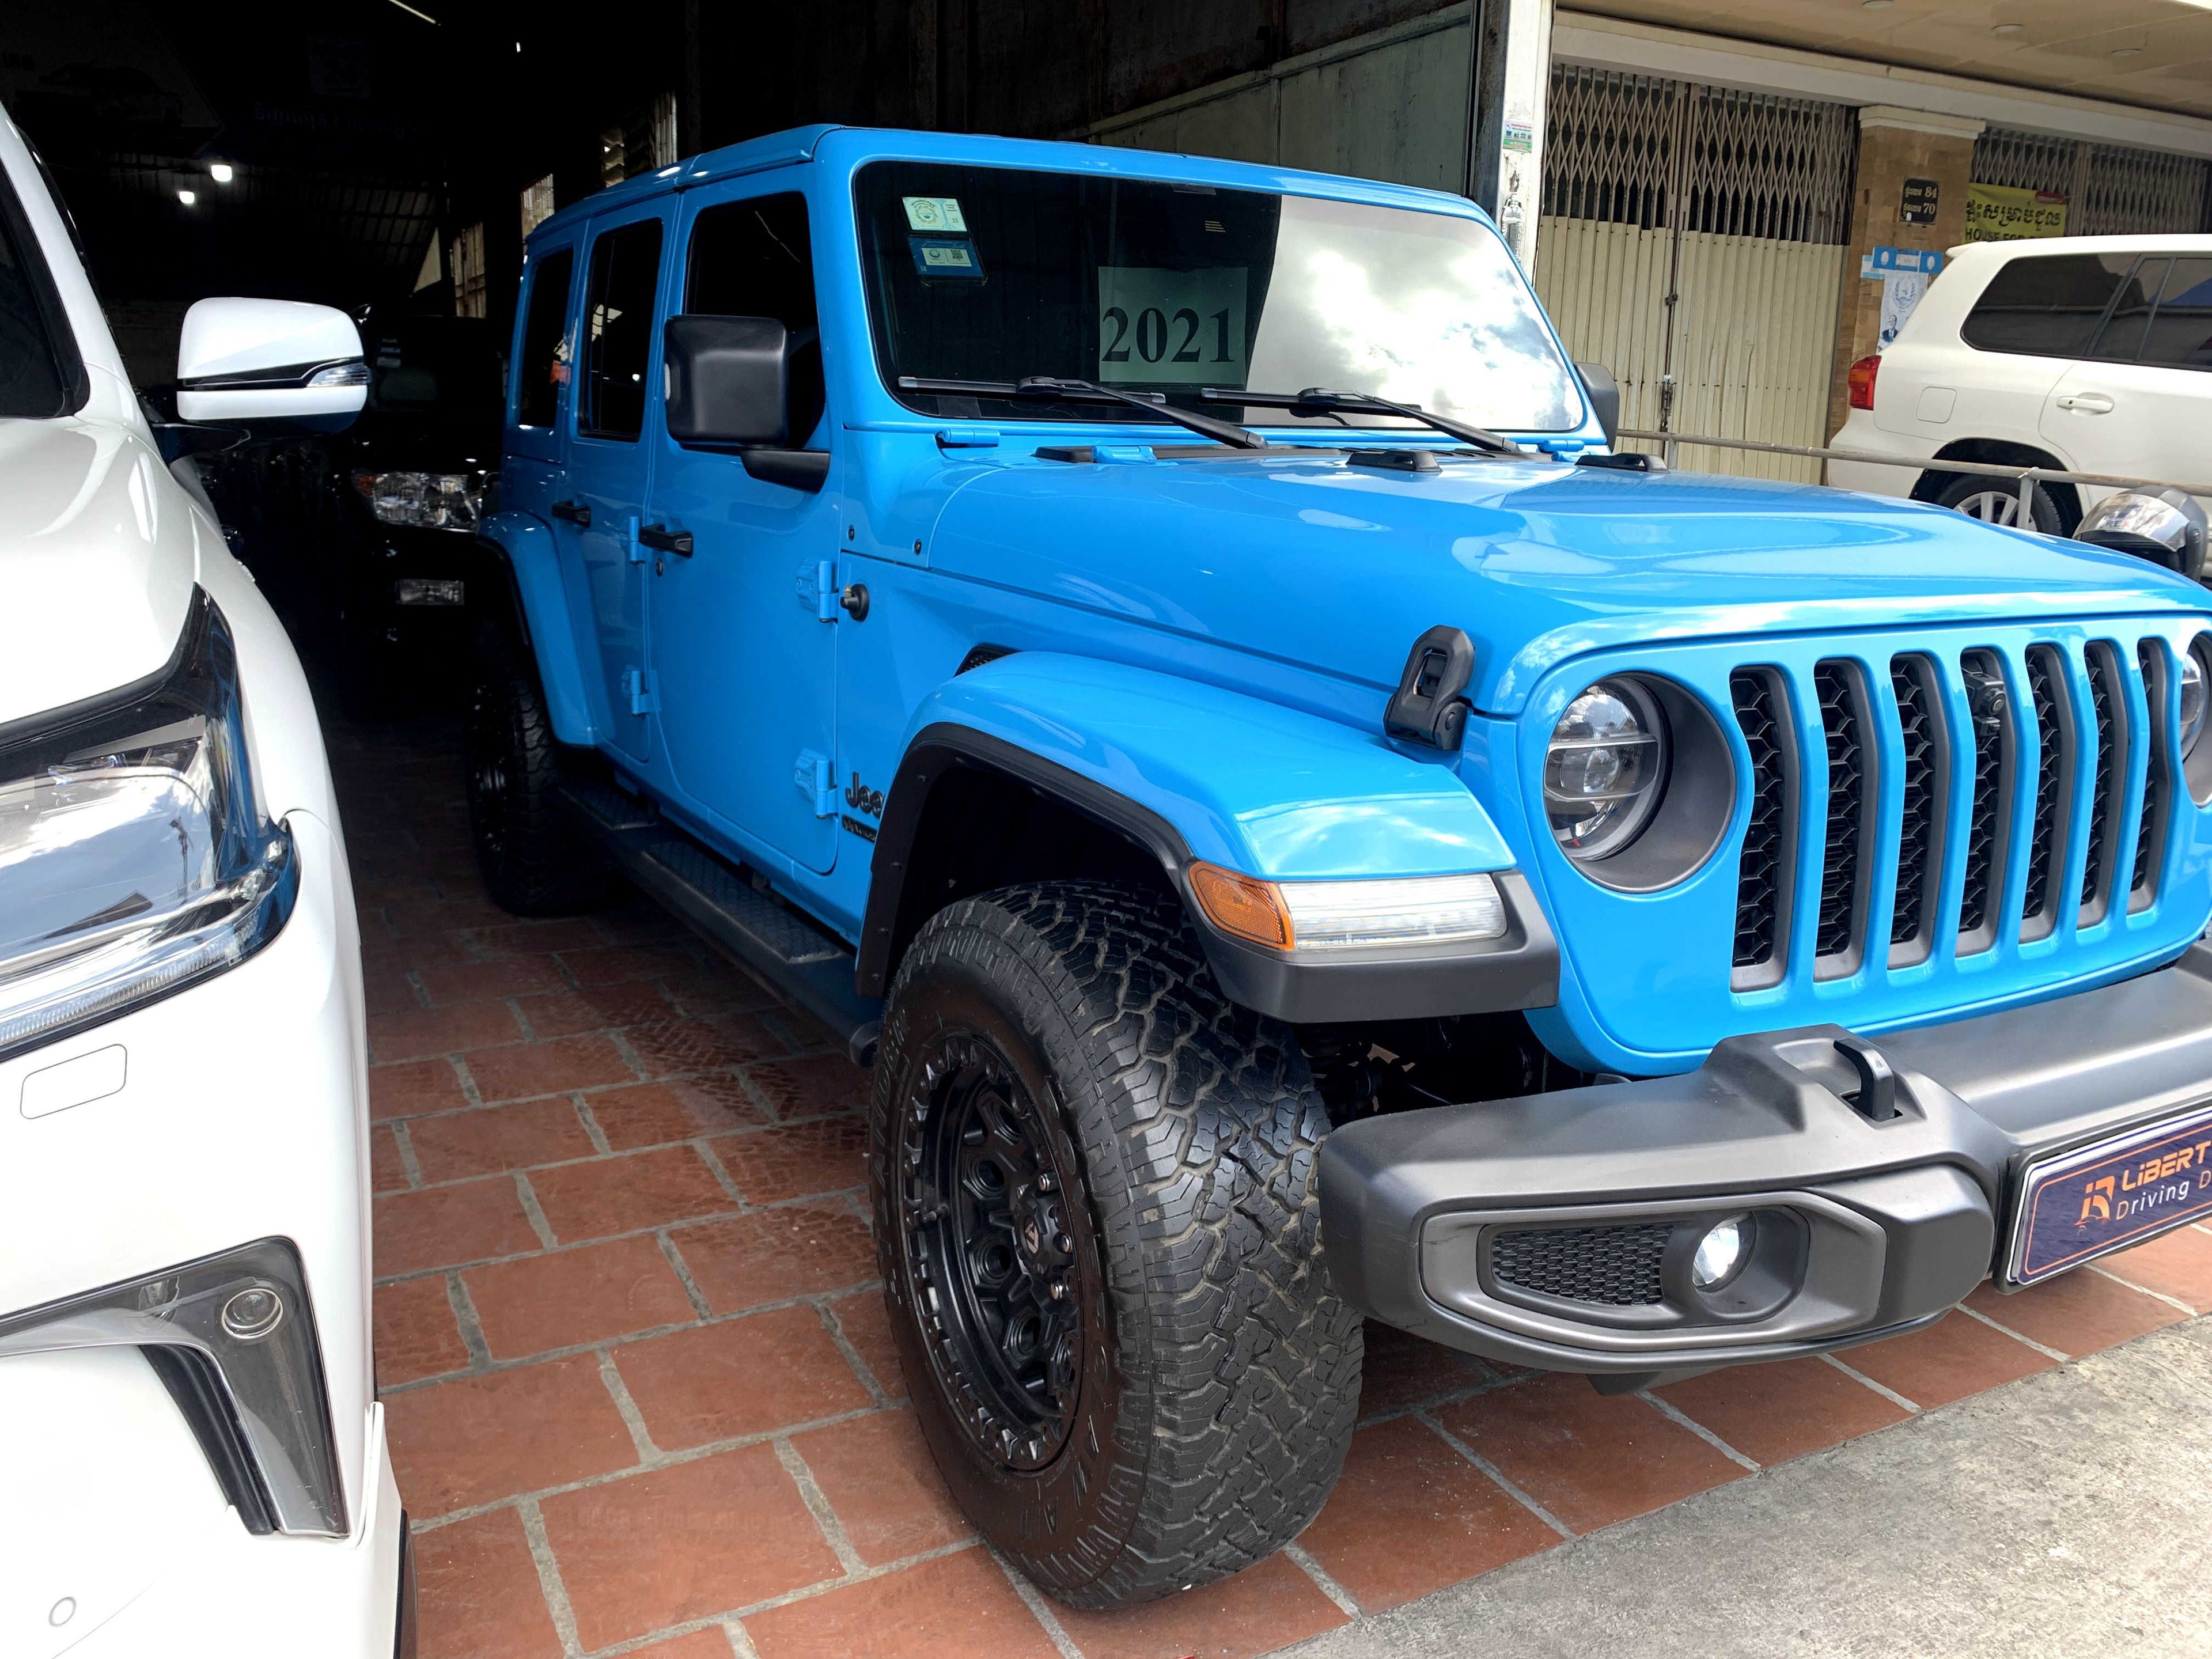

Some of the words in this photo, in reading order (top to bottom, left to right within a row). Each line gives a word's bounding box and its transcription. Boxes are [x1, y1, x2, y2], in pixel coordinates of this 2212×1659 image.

[1923, 202, 1936, 214] 70
[1925, 186, 1937, 198] 84
[1101, 306, 1234, 363] 2021
[845, 771, 885, 820] Jee
[2115, 1180, 2190, 1221] Driving
